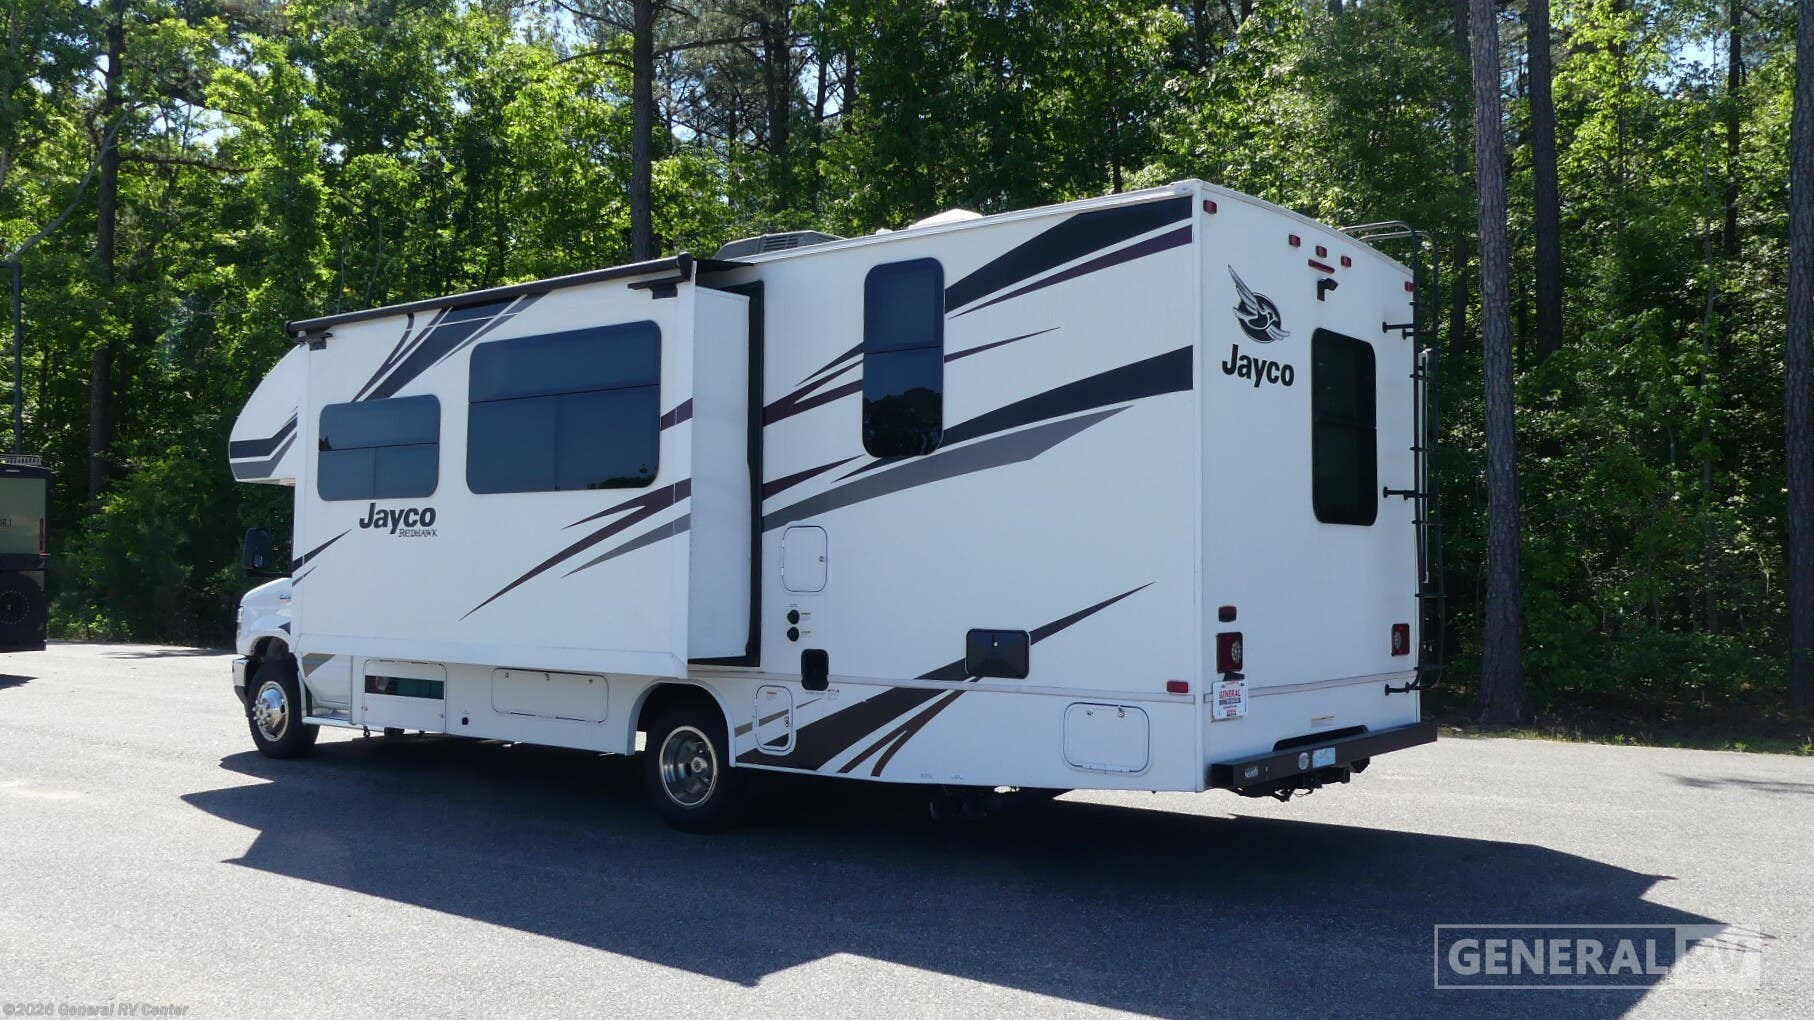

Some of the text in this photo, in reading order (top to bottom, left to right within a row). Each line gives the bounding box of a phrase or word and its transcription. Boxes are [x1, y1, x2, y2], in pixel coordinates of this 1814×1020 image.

[1222, 344, 1294, 388] Jayco
[359, 502, 437, 534] Jayco
[398, 528, 438, 538] REDHAWK
